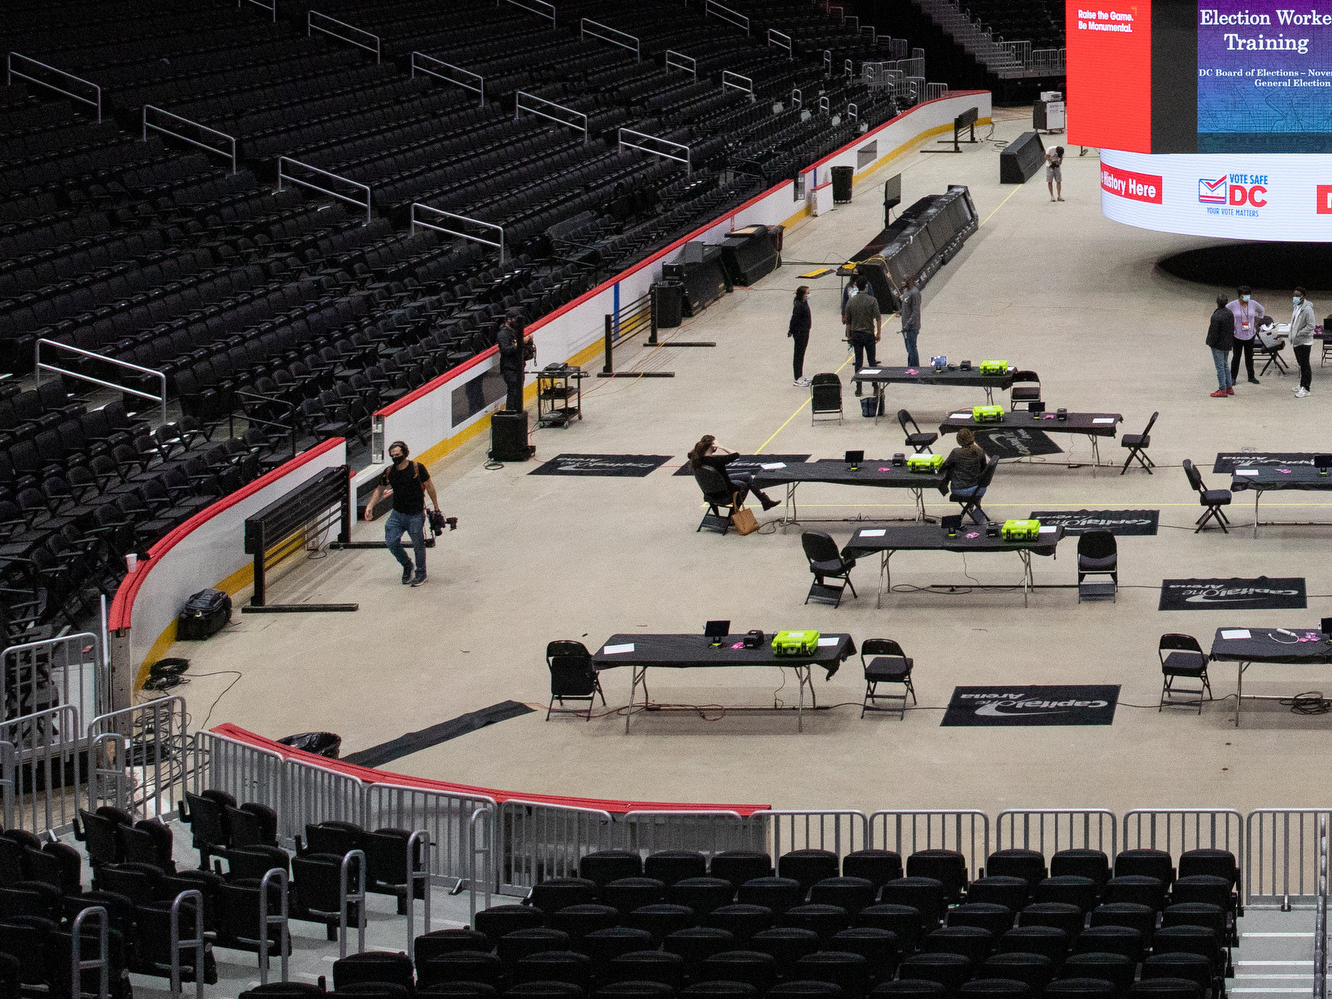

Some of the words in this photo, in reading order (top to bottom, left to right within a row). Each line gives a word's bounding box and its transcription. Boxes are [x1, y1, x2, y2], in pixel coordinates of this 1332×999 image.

[1078, 9, 1096, 19] Raise
[1098, 10, 1109, 20] the
[1110, 11, 1134, 21] Game.
[1200, 9, 1271, 26] Election
[1078, 20, 1087, 30] Be
[1088, 21, 1133, 32] Monumental.
[1224, 33, 1309, 54] Training
[1199, 69, 1213, 77] DC
[1215, 68, 1244, 77] Board
[1246, 68, 1256, 77] of
[1257, 68, 1299, 77] Elections
[1254, 79, 1291, 87] General
[1293, 79, 1331, 87] Election
[1103, 171, 1126, 195] History
[1128, 179, 1156, 198] Here
[1229, 173, 1248, 185] VOTE
[1249, 174, 1268, 185] SAFE
[1229, 185, 1268, 207] DC
[1206, 206, 1220, 215] YOUR
[1221, 207, 1235, 216] VOTE
[1236, 208, 1259, 217] MATTERS
